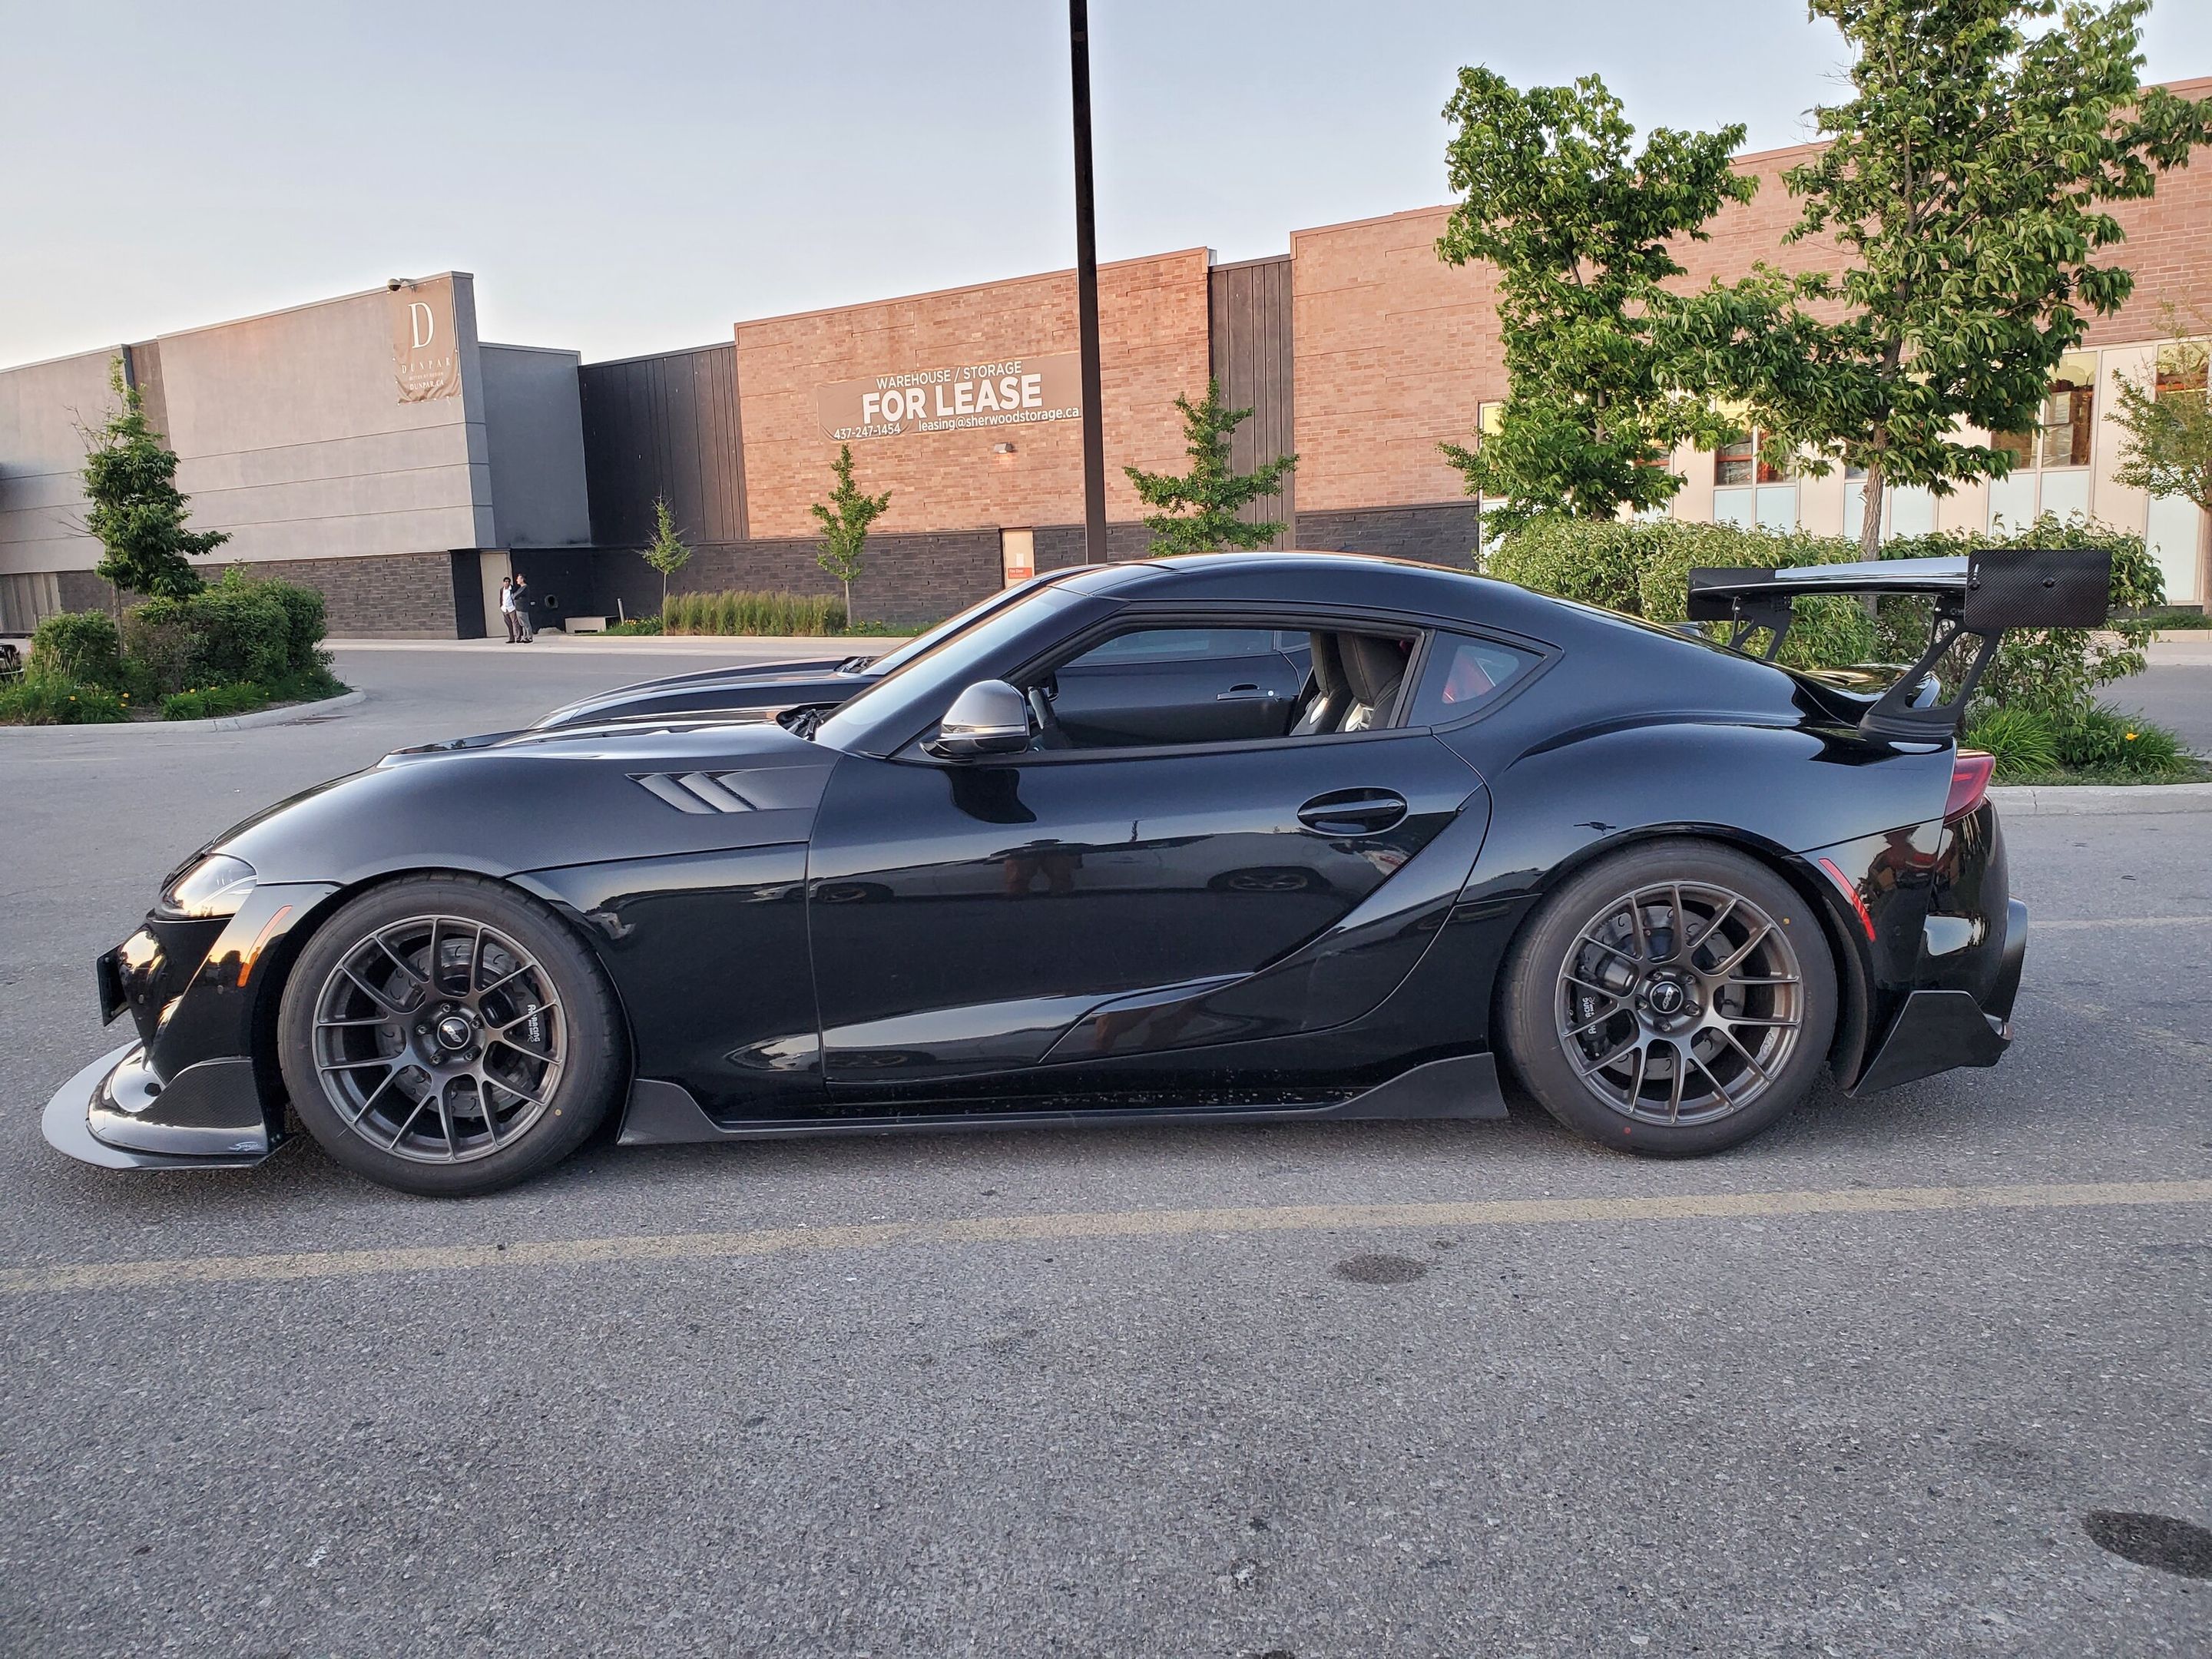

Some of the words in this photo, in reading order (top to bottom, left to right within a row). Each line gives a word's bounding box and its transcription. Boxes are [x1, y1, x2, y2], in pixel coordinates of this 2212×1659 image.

[408, 302, 434, 349] D
[876, 369, 952, 389] WAREHOUSE
[953, 366, 961, 383] /
[963, 360, 1022, 380] STORAGE
[862, 386, 928, 424] FOR
[935, 373, 1043, 417] LEASE
[833, 422, 901, 440] 437-247-1454
[918, 407, 1080, 432] leasing@sherwoodstorage.ca
[1582, 997, 1591, 1018] ACING
